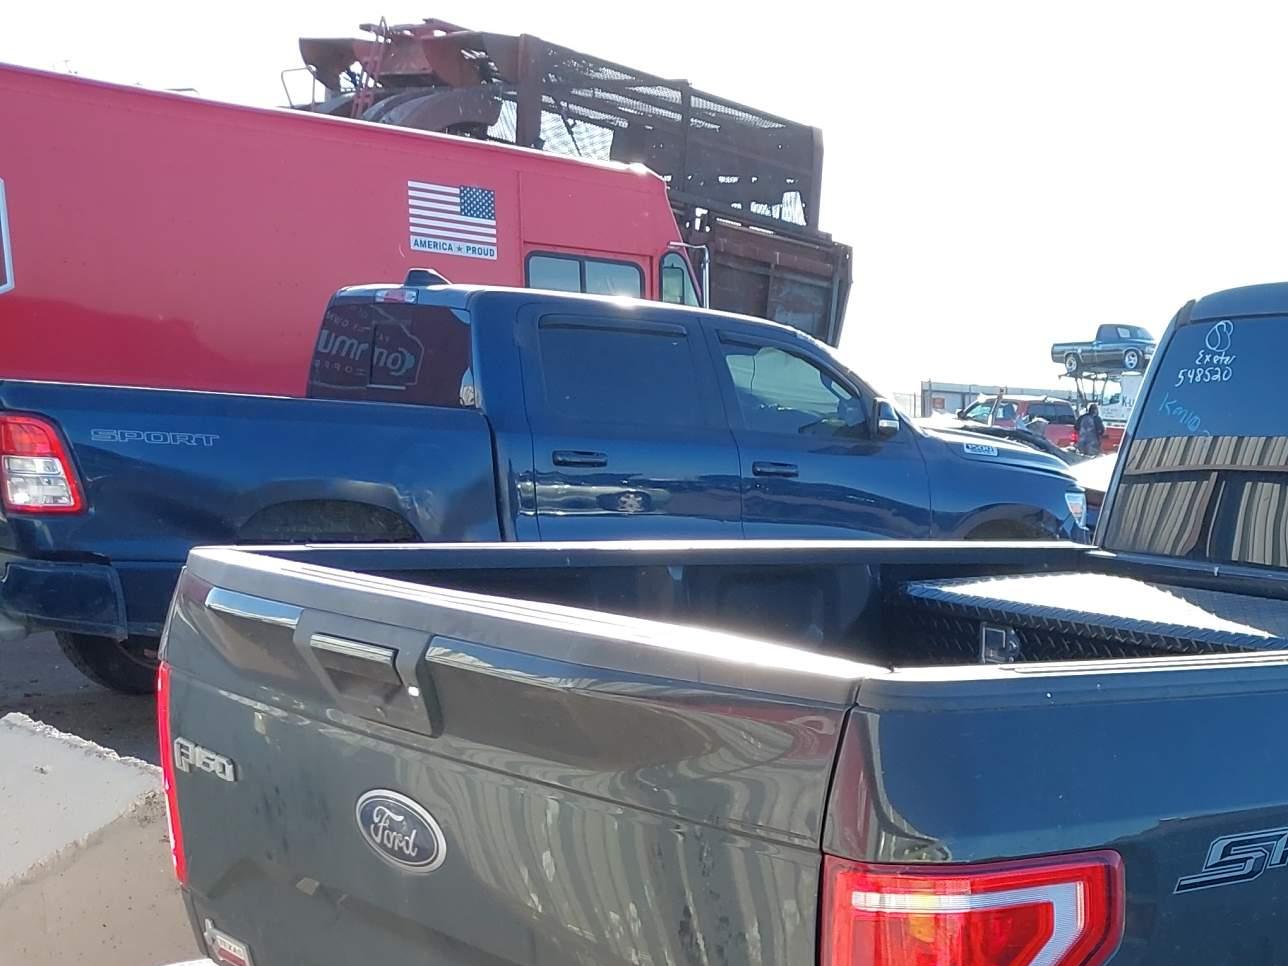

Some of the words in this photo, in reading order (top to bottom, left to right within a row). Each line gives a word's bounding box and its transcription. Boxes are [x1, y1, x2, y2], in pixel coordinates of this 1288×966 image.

[413, 238, 454, 252] AMERICA
[466, 245, 496, 257] PROUD
[1175, 366, 1232, 388] 548520
[91, 428, 221, 447] SPORT
[370, 805, 418, 857] Ford
